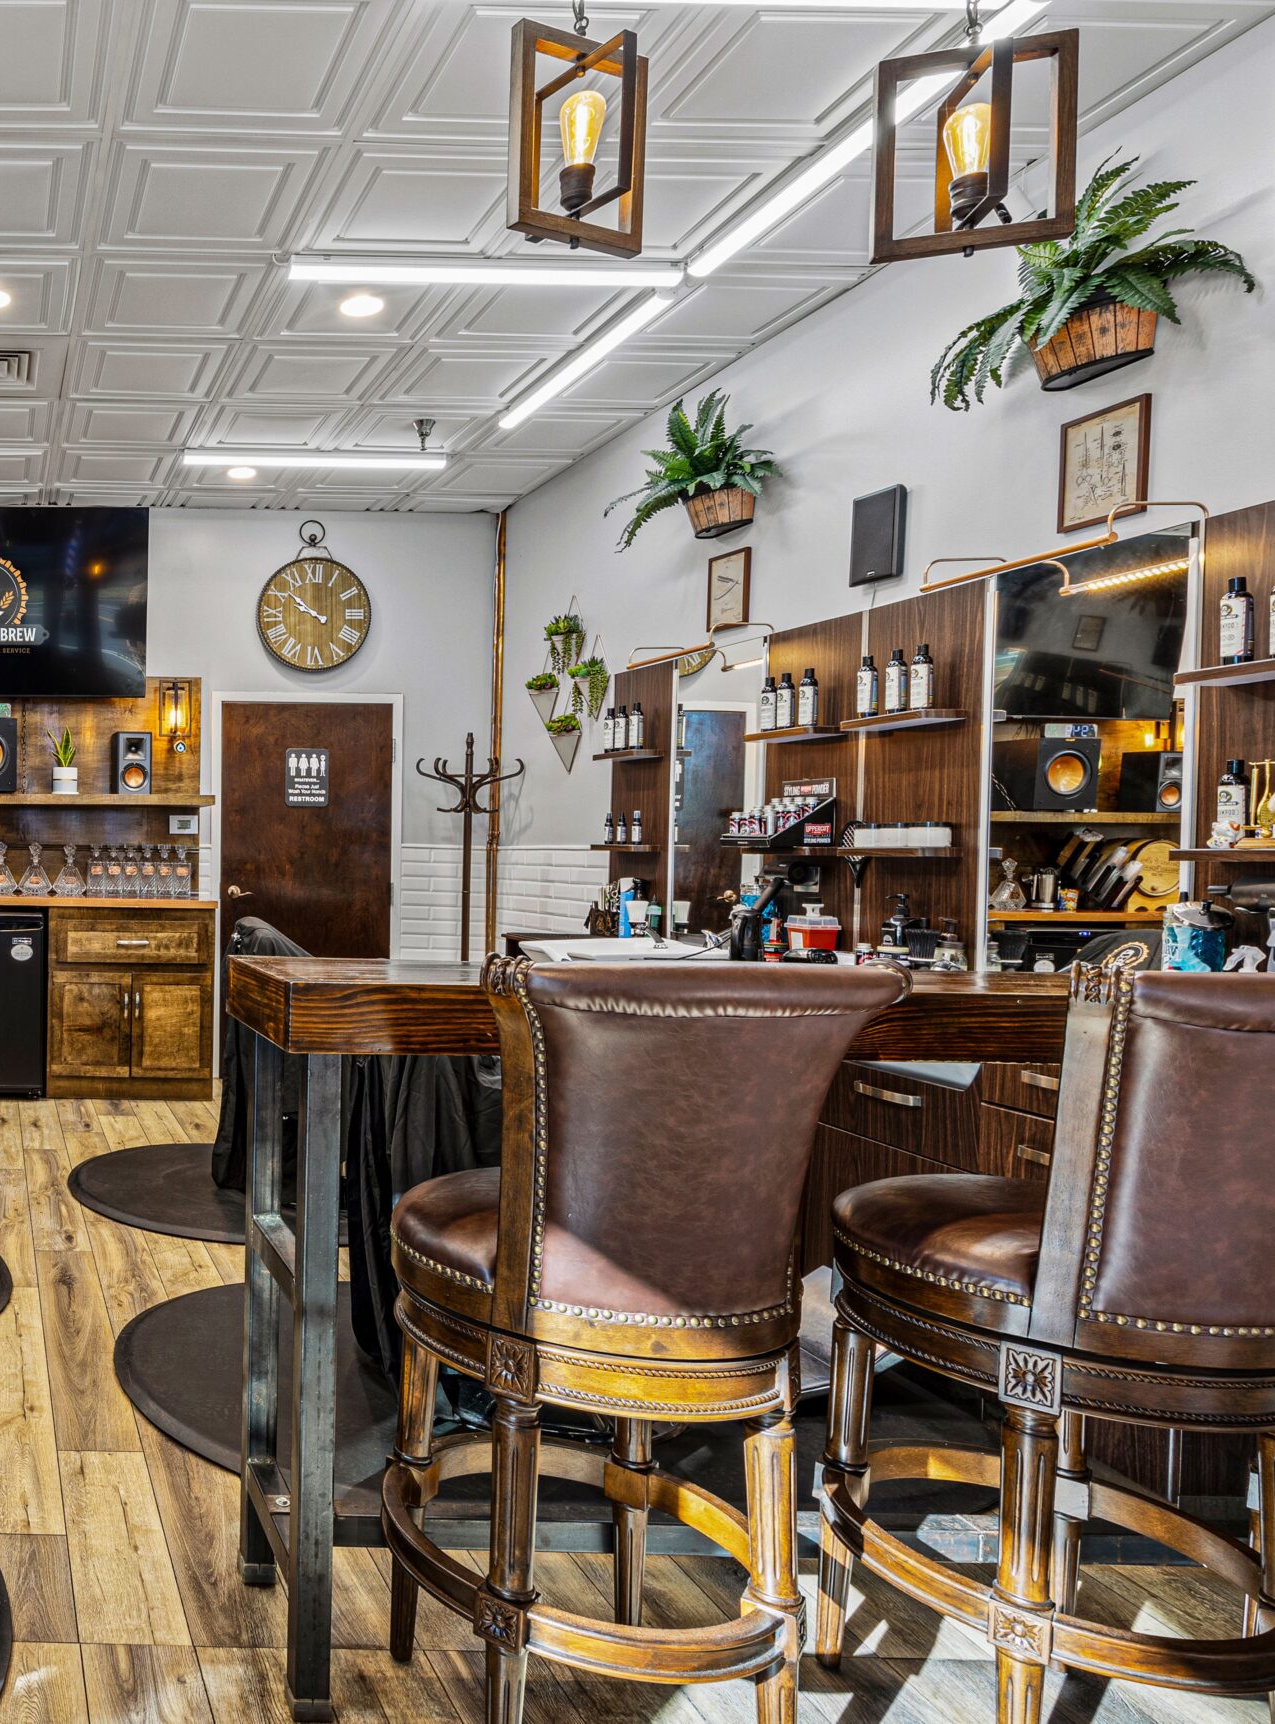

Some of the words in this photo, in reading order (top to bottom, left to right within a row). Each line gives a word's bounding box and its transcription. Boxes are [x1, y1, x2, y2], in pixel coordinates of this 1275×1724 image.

[282, 568, 302, 590] XI
[304, 564, 323, 583] XII
[328, 570, 340, 587] I
[268, 586, 289, 604] X
[340, 586, 358, 600] II
[264, 606, 282, 622] IX
[346, 608, 364, 620] III
[0, 628, 36, 642] BREW
[266, 624, 289, 646] VIII
[281, 638, 301, 662] VII
[307, 646, 324, 665] VI
[329, 642, 344, 660] V
[784, 786, 800, 796] STYLING
[812, 784, 830, 794] POWDER
